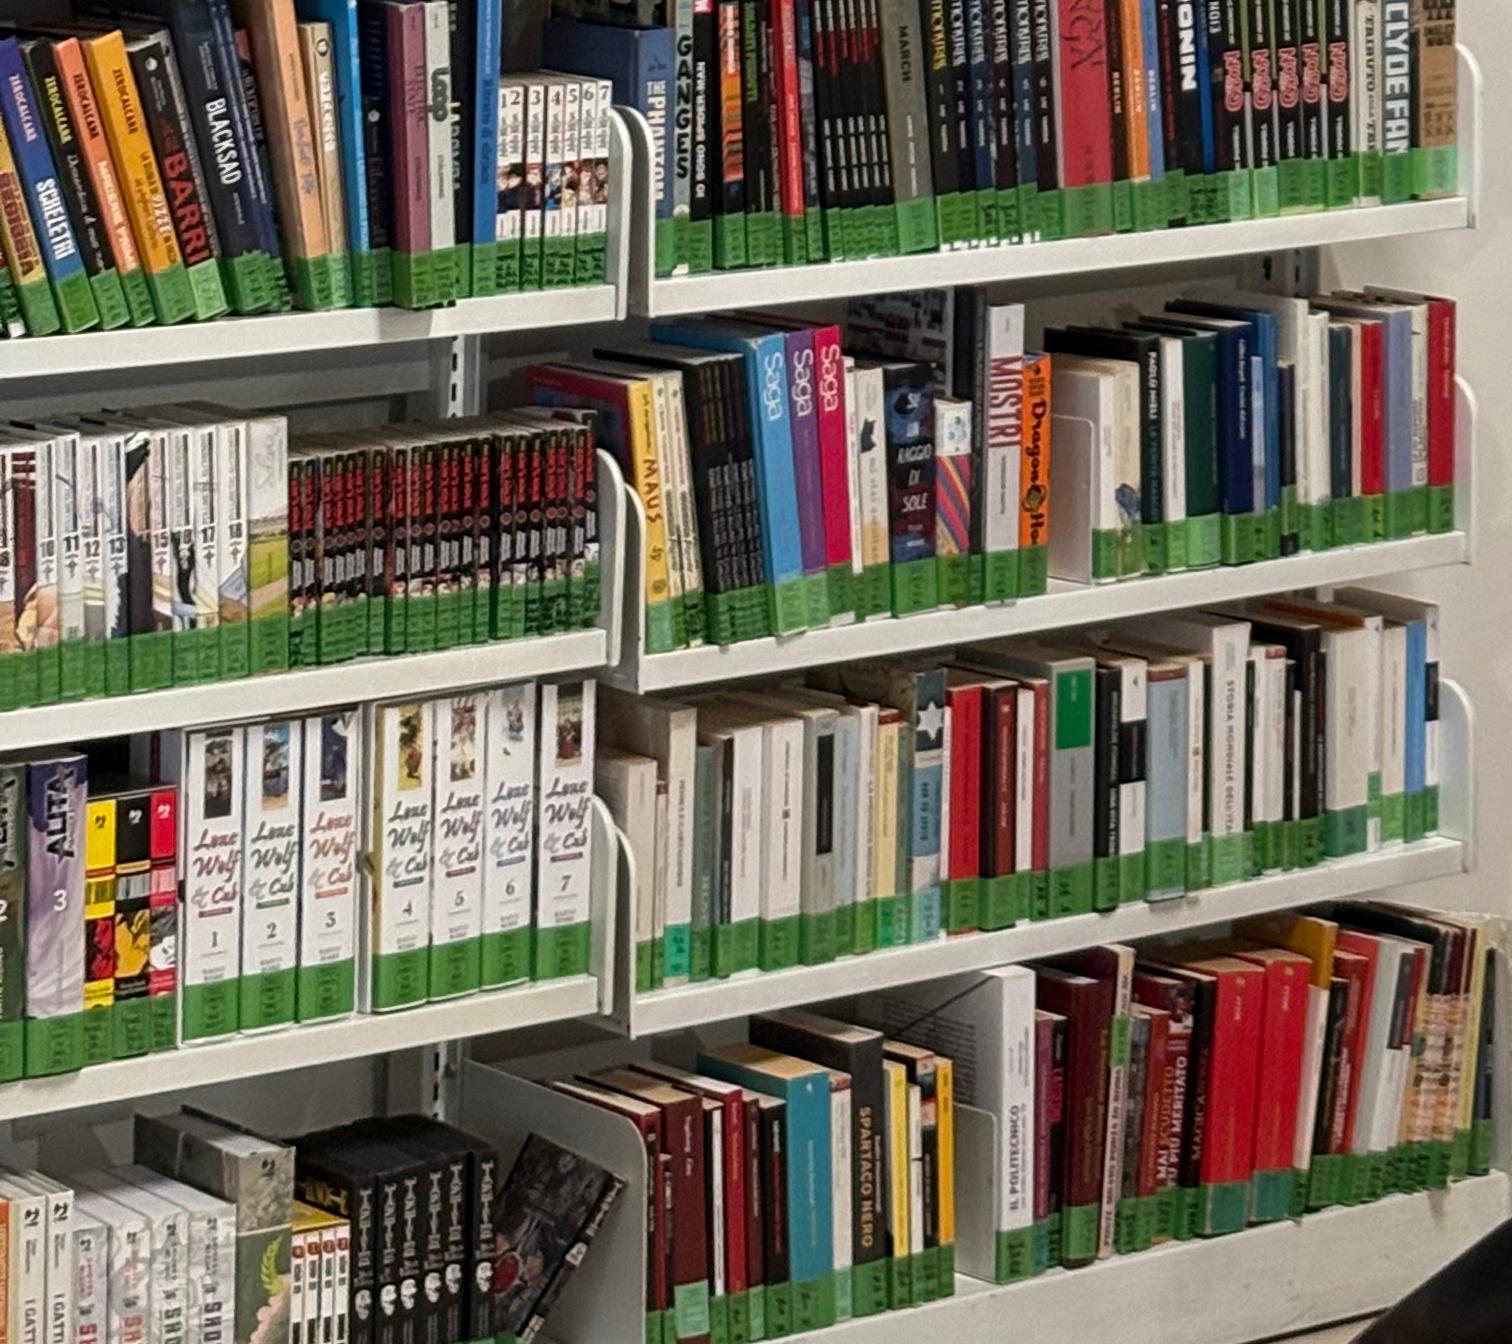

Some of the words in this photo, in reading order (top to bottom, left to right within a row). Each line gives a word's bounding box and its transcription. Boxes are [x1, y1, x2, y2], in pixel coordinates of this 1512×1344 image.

[898, 25, 913, 83] MARCH
[1365, 14, 1376, 92] TRIBUTO
[1384, 1, 1409, 94] CLYDE
[112, 68, 139, 135] ZEROCALCARE
[425, 66, 449, 122] Loop
[675, 35, 693, 179] GANGES
[1112, 72, 1121, 115] BERLIN
[1147, 70, 1158, 111] BERLIN
[205, 97, 242, 185] BLACKSAD
[646, 96, 666, 201] PHANTOM
[1384, 99, 1409, 154] FAN
[9, 73, 38, 142] ZEROCALCARE
[35, 177, 75, 260] SCHELETRI
[162, 153, 211, 263] BARRI
[764, 352, 784, 421] Saga
[792, 348, 813, 417] Saga
[820, 344, 842, 412] Saga
[988, 355, 1024, 448] MOSTRI
[1025, 400, 1047, 483] Dragon
[643, 458, 662, 524] MAUS
[902, 493, 928, 512] SOLE
[1226, 680, 1235, 721] STORIA
[1226, 726, 1234, 782] MONDIALE
[439, 810, 482, 843] Wolf
[489, 800, 532, 832] Wolf
[543, 799, 591, 829] Wolf
[1226, 786, 1234, 833] DELL'ITA
[252, 840, 299, 874] Wolf
[308, 831, 356, 862] Wolf
[387, 820, 430, 852] Wolf
[193, 850, 241, 883] Wolf
[505, 878, 516, 896] 6
[560, 875, 571, 892] 7
[53, 888, 68, 912] 3
[325, 912, 337, 927] 3
[403, 902, 413, 917] 4
[454, 891, 465, 907] 5
[212, 932, 219, 947] 1
[266, 922, 277, 939] 2
[1159, 1066, 1175, 1145] SCUDETTO
[859, 1106, 872, 1195] SPARTACO
[1009, 1105, 1021, 1194] POLITECNICO
[1156, 1149, 1169, 1179] MAI
[861, 1200, 872, 1249] NERO
[1009, 1197, 1020, 1210] IL
